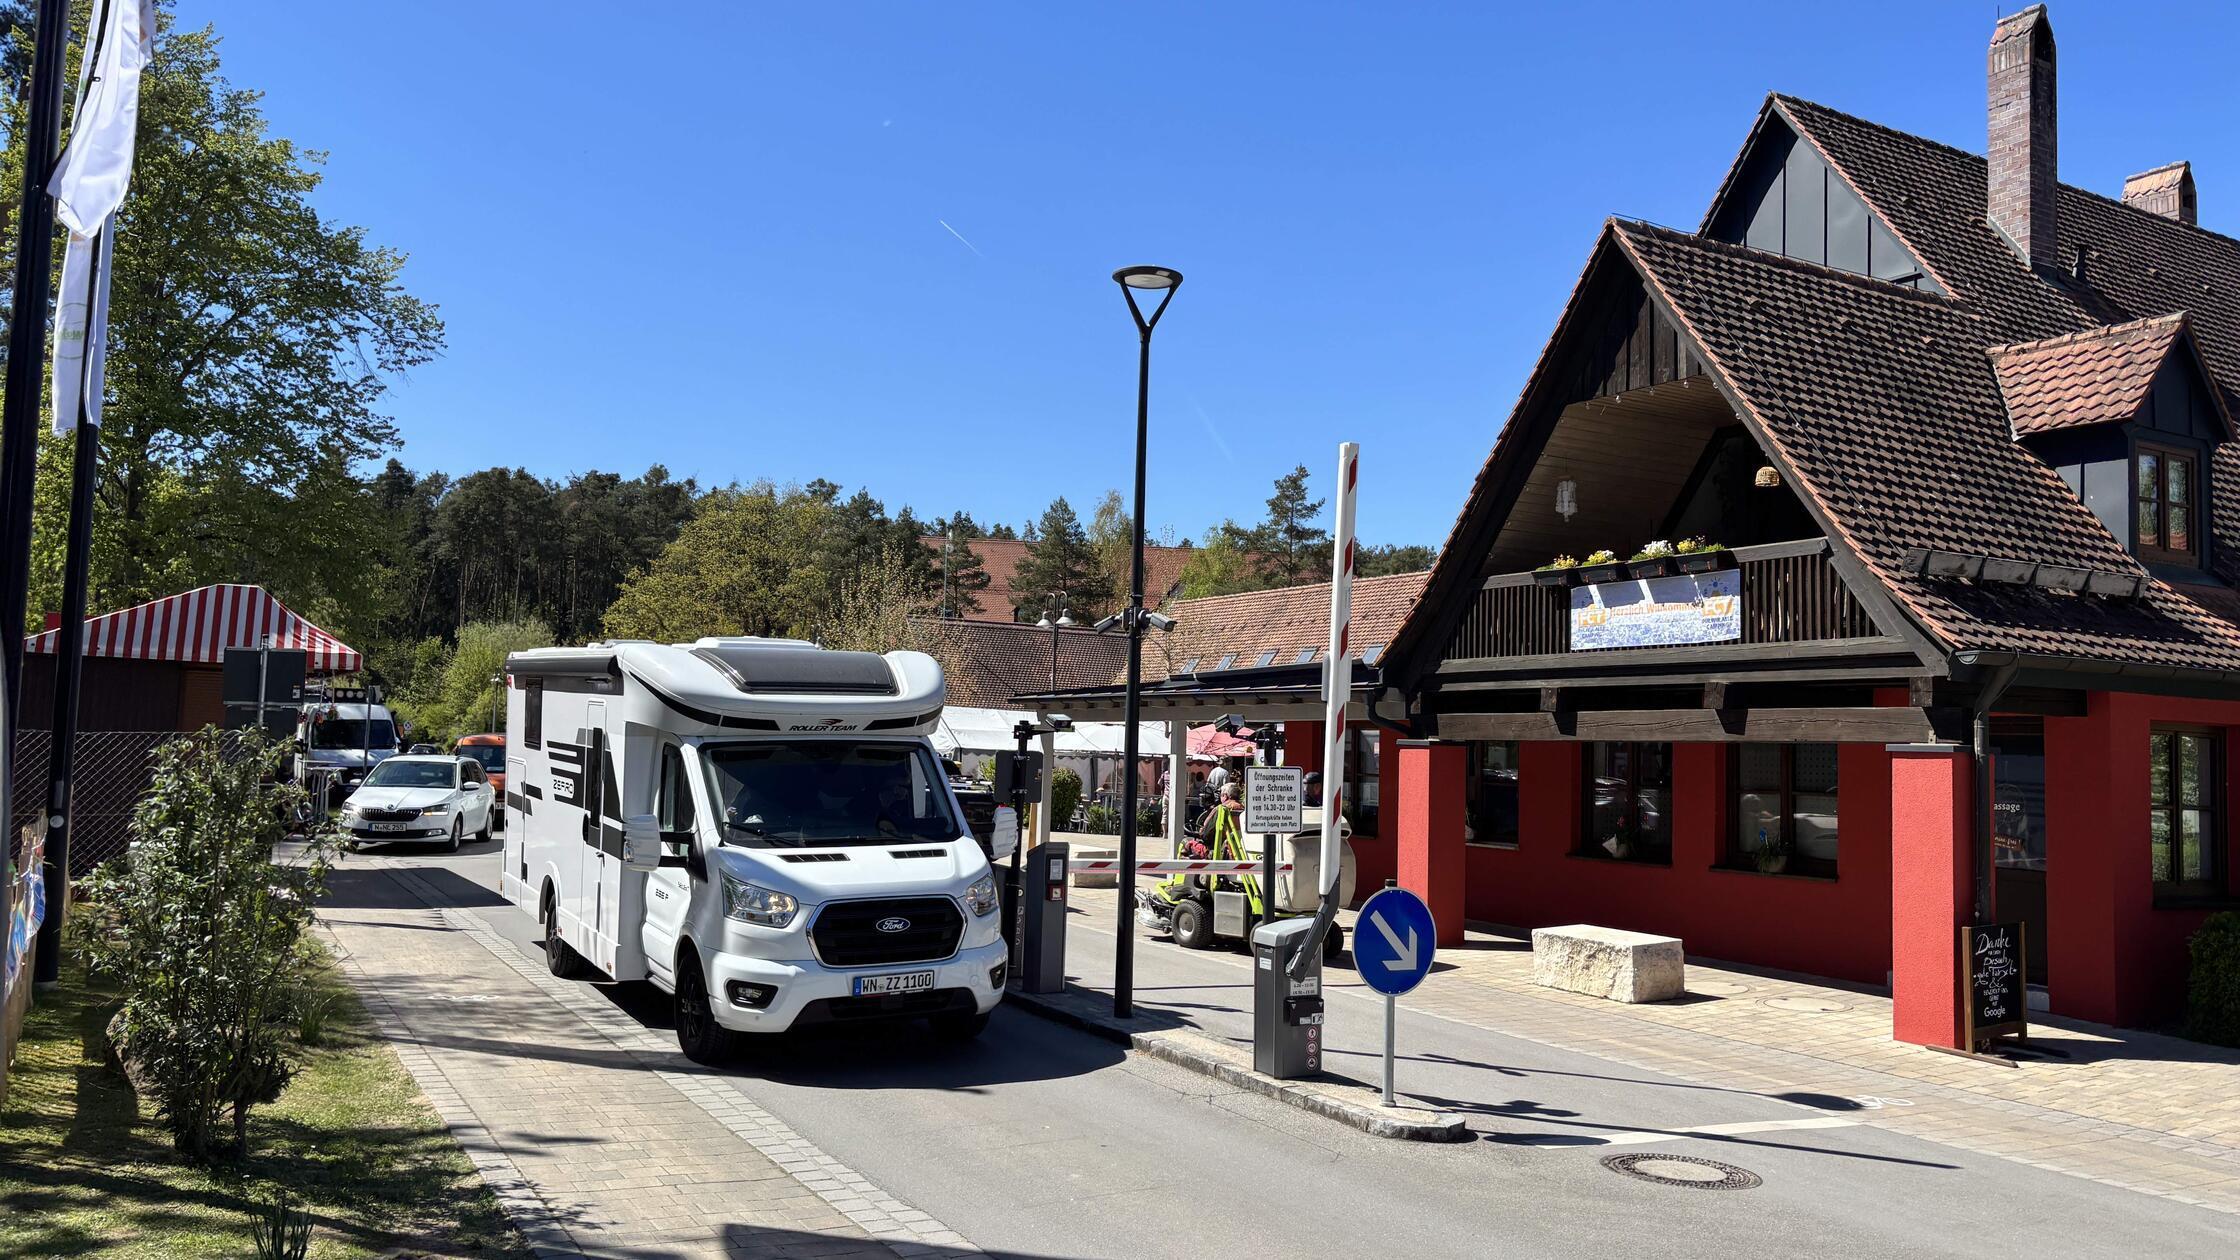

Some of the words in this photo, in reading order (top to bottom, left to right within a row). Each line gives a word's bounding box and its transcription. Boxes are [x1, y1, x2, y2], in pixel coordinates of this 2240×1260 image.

[789, 724, 829, 732] ROLLER
[830, 724, 859, 732] TEAM
[1253, 771, 1295, 783] Öffnungszeiten
[1255, 783, 1265, 792] der
[1267, 783, 1293, 792] Schranke
[1263, 794, 1275, 802] 6-13
[1276, 794, 1286, 802] Uhr
[1287, 794, 1297, 802] und
[1286, 803, 1296, 811] Uhr
[1993, 803, 2021, 813] assage
[882, 919, 905, 930] Ford
[1975, 927, 2012, 956] Danke
[862, 978, 878, 993] WN
[886, 976, 901, 991] ZZ
[903, 973, 932, 989] 1100
[1983, 1005, 2006, 1018] Google
